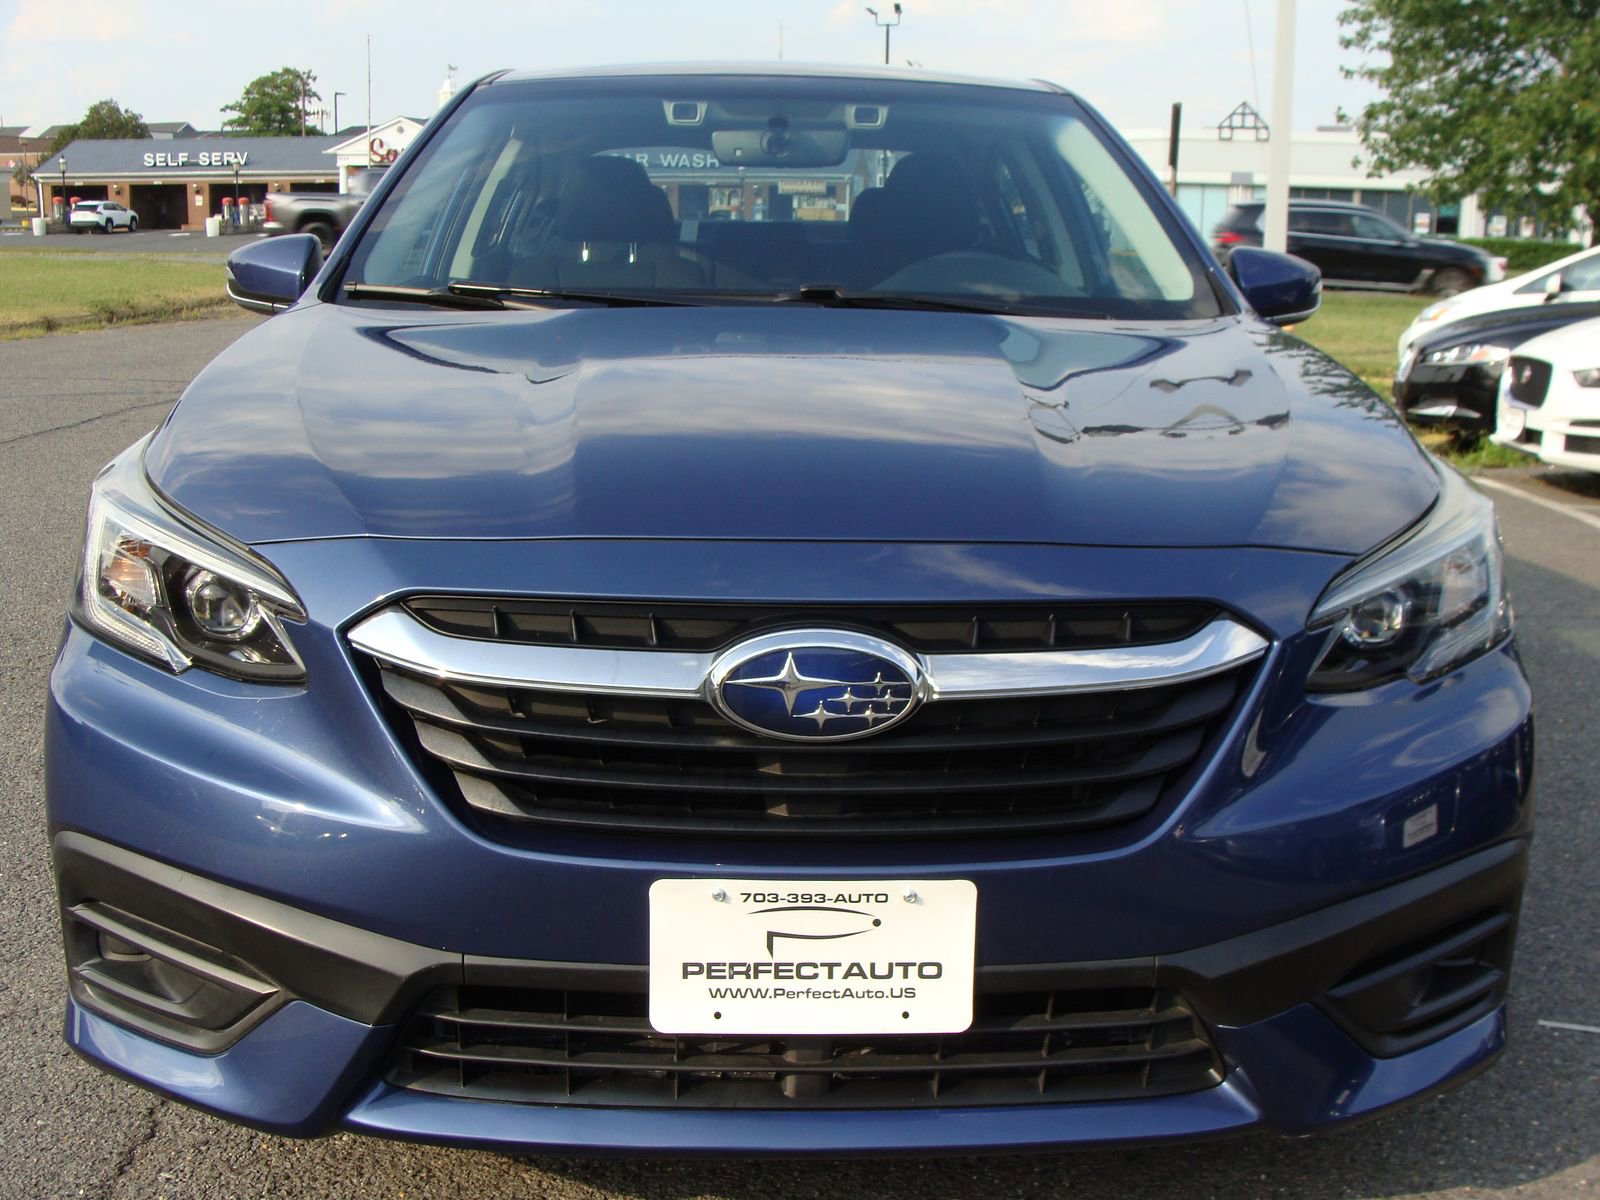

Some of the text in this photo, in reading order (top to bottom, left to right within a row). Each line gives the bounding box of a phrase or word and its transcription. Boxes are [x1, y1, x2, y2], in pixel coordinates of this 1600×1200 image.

[370, 137, 404, 164] So
[143, 151, 248, 167] SELF SERV
[660, 153, 720, 168] WASH
[740, 892, 889, 904] 703-393-AUTO
[682, 961, 943, 980] PERFECTAUTO
[708, 987, 916, 999] WWW.PerfectAuto.US
